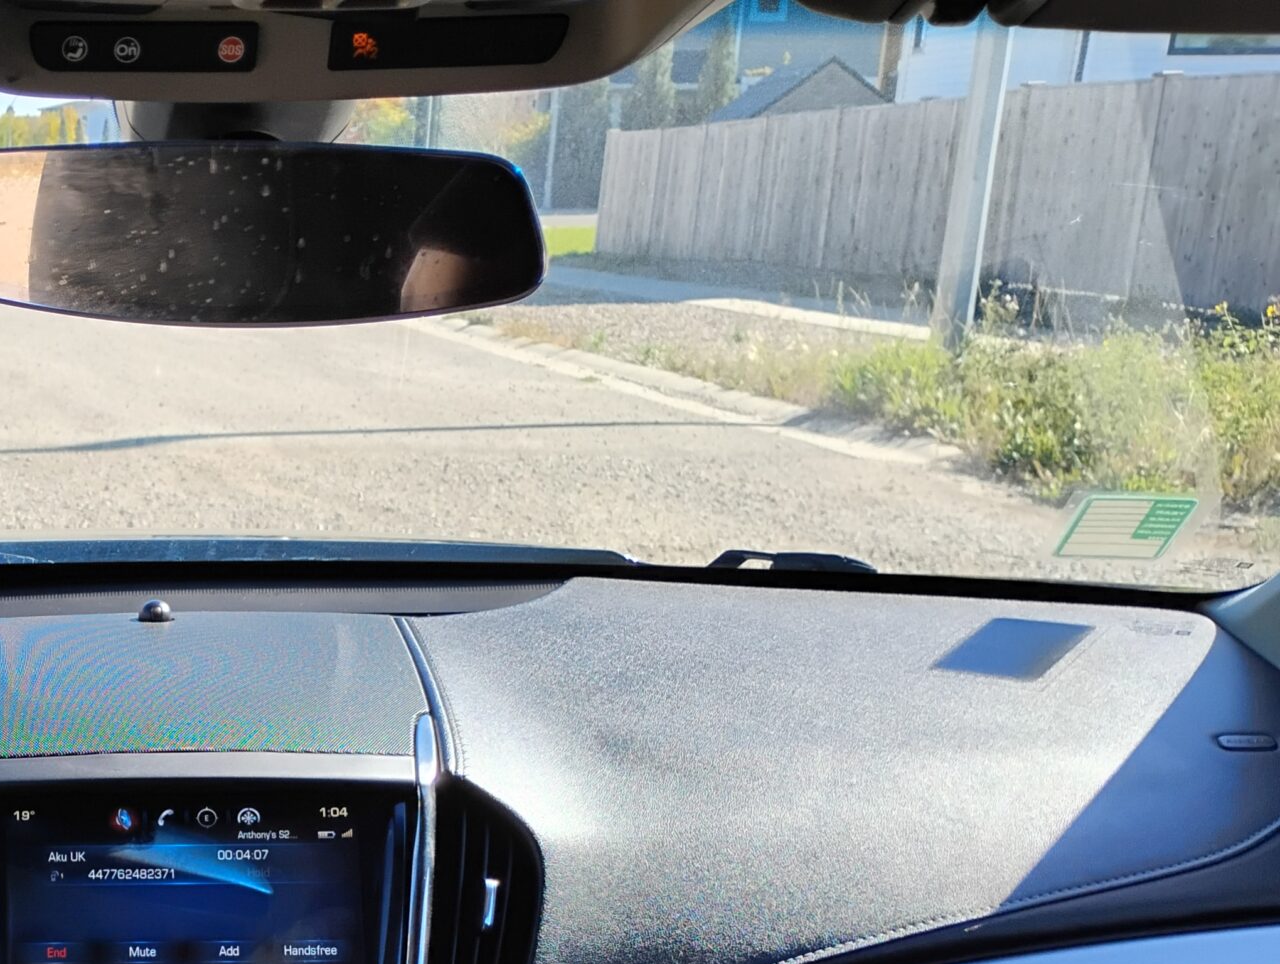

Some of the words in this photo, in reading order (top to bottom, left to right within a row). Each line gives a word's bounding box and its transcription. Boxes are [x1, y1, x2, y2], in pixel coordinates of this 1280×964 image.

[219, 43, 243, 56] SOS
[319, 806, 349, 818] 1:04
[237, 829, 277, 841] Anthony's
[47, 851, 68, 863] Aku
[70, 851, 86, 862] UK
[217, 849, 270, 861] 00:04:07
[87, 868, 176, 880] 447762482371
[46, 947, 67, 958] End
[129, 946, 157, 958] Mute
[219, 945, 240, 957] Add
[283, 944, 338, 956] Handsfree
